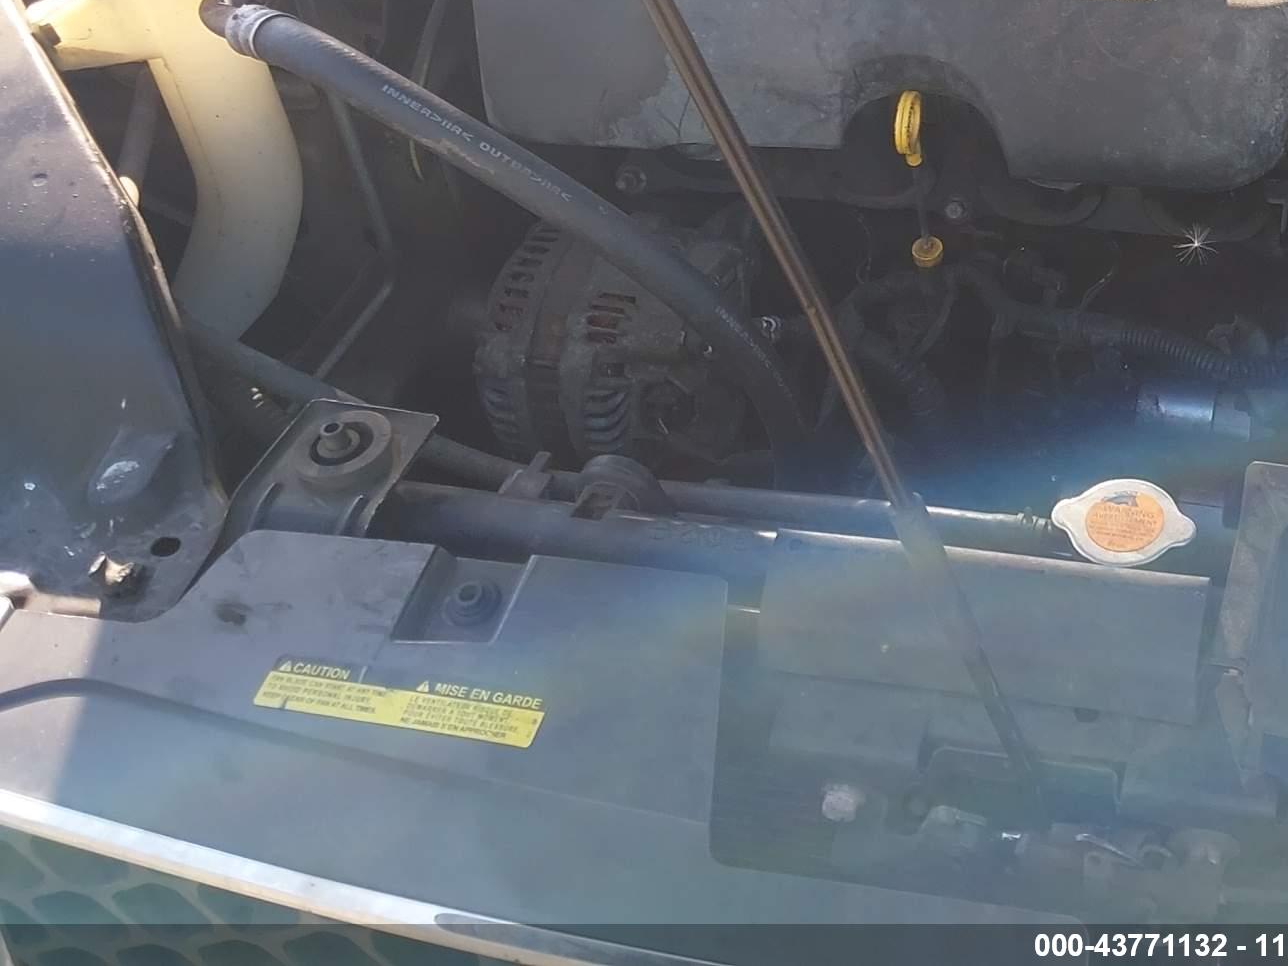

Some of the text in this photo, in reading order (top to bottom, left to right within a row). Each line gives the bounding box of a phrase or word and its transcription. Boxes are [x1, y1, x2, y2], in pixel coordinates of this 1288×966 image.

[293, 663, 351, 680] CAUTION
[434, 683, 543, 710] MISE EN GARDE
